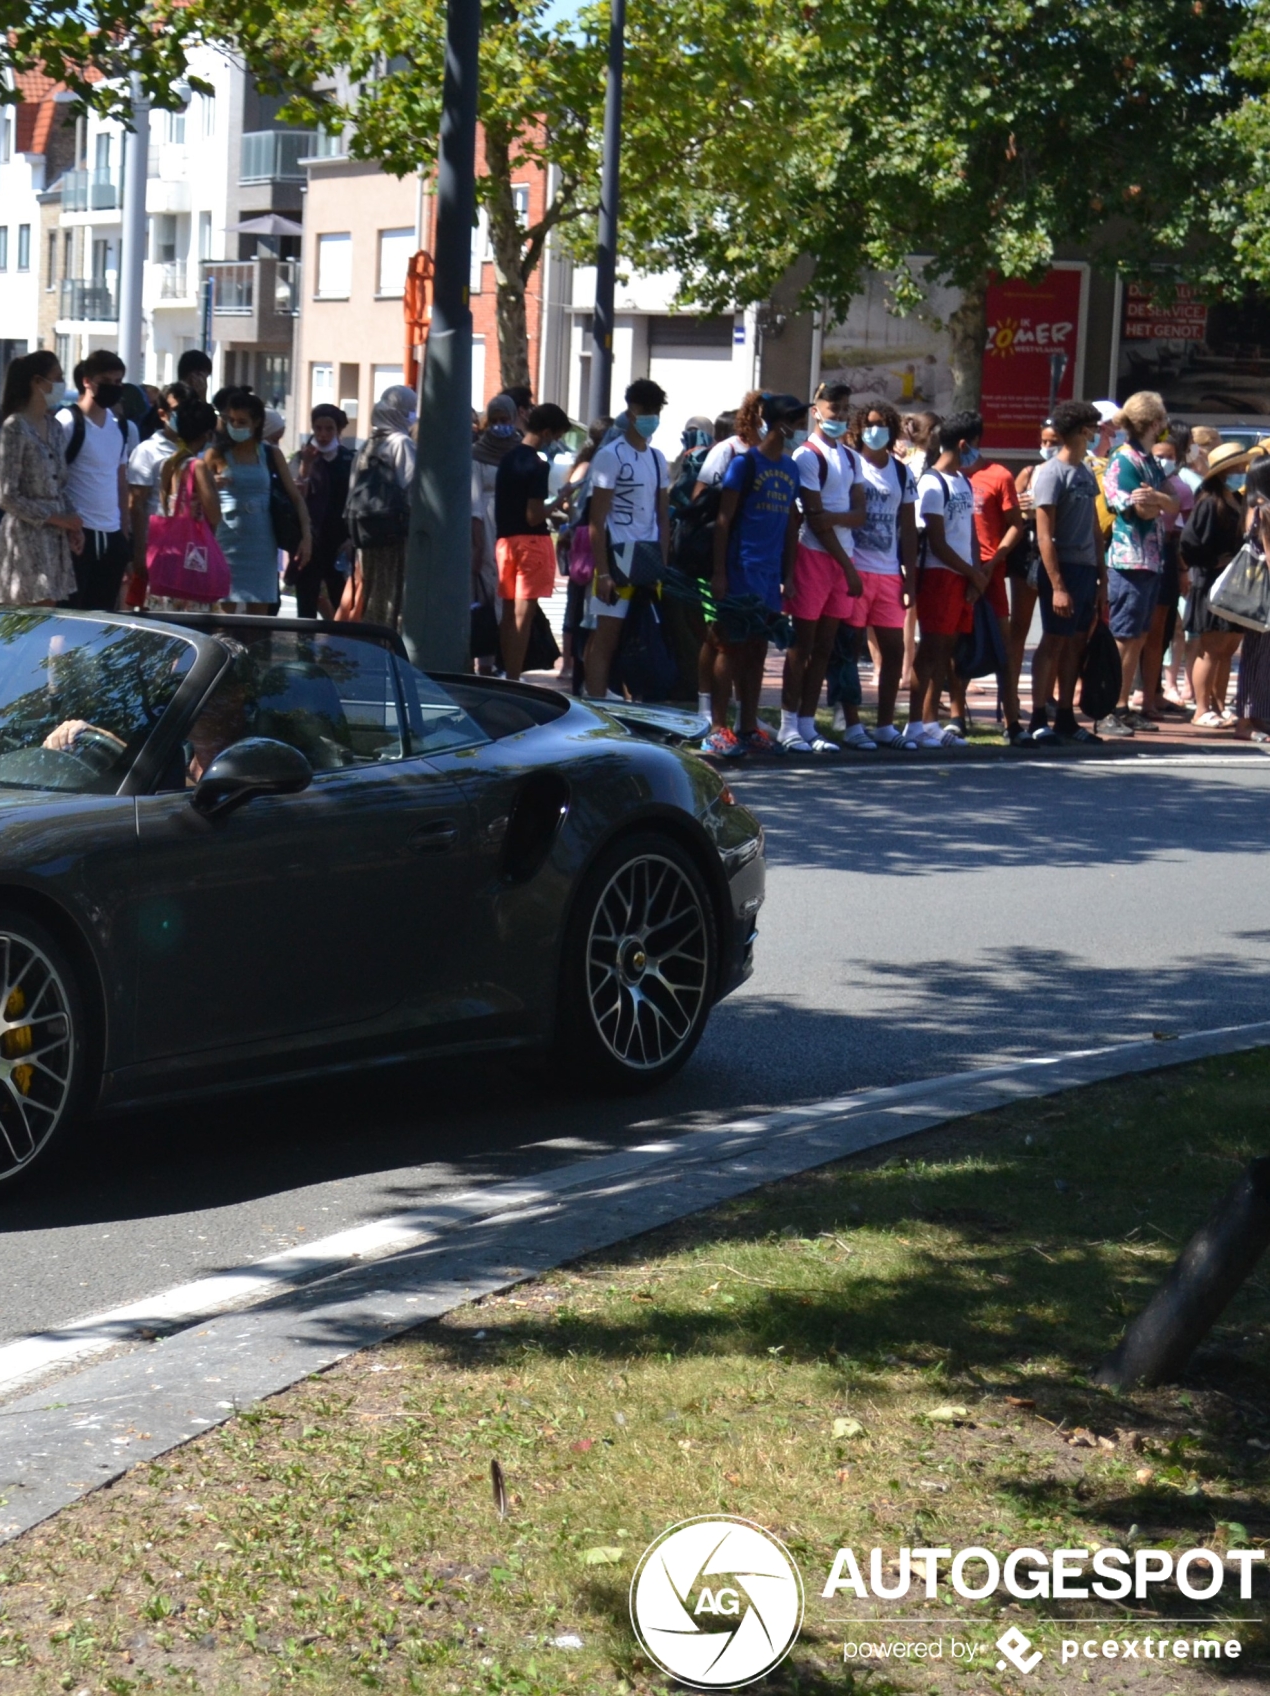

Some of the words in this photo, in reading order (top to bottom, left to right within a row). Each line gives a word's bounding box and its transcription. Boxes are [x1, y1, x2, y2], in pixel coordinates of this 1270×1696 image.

[1128, 304, 1146, 316] DE
[1020, 318, 1030, 327] IK
[985, 321, 1073, 349] ZOMER
[1126, 323, 1153, 336] HET
[1154, 325, 1201, 338] GENOT.
[614, 441, 645, 526] Calvin
